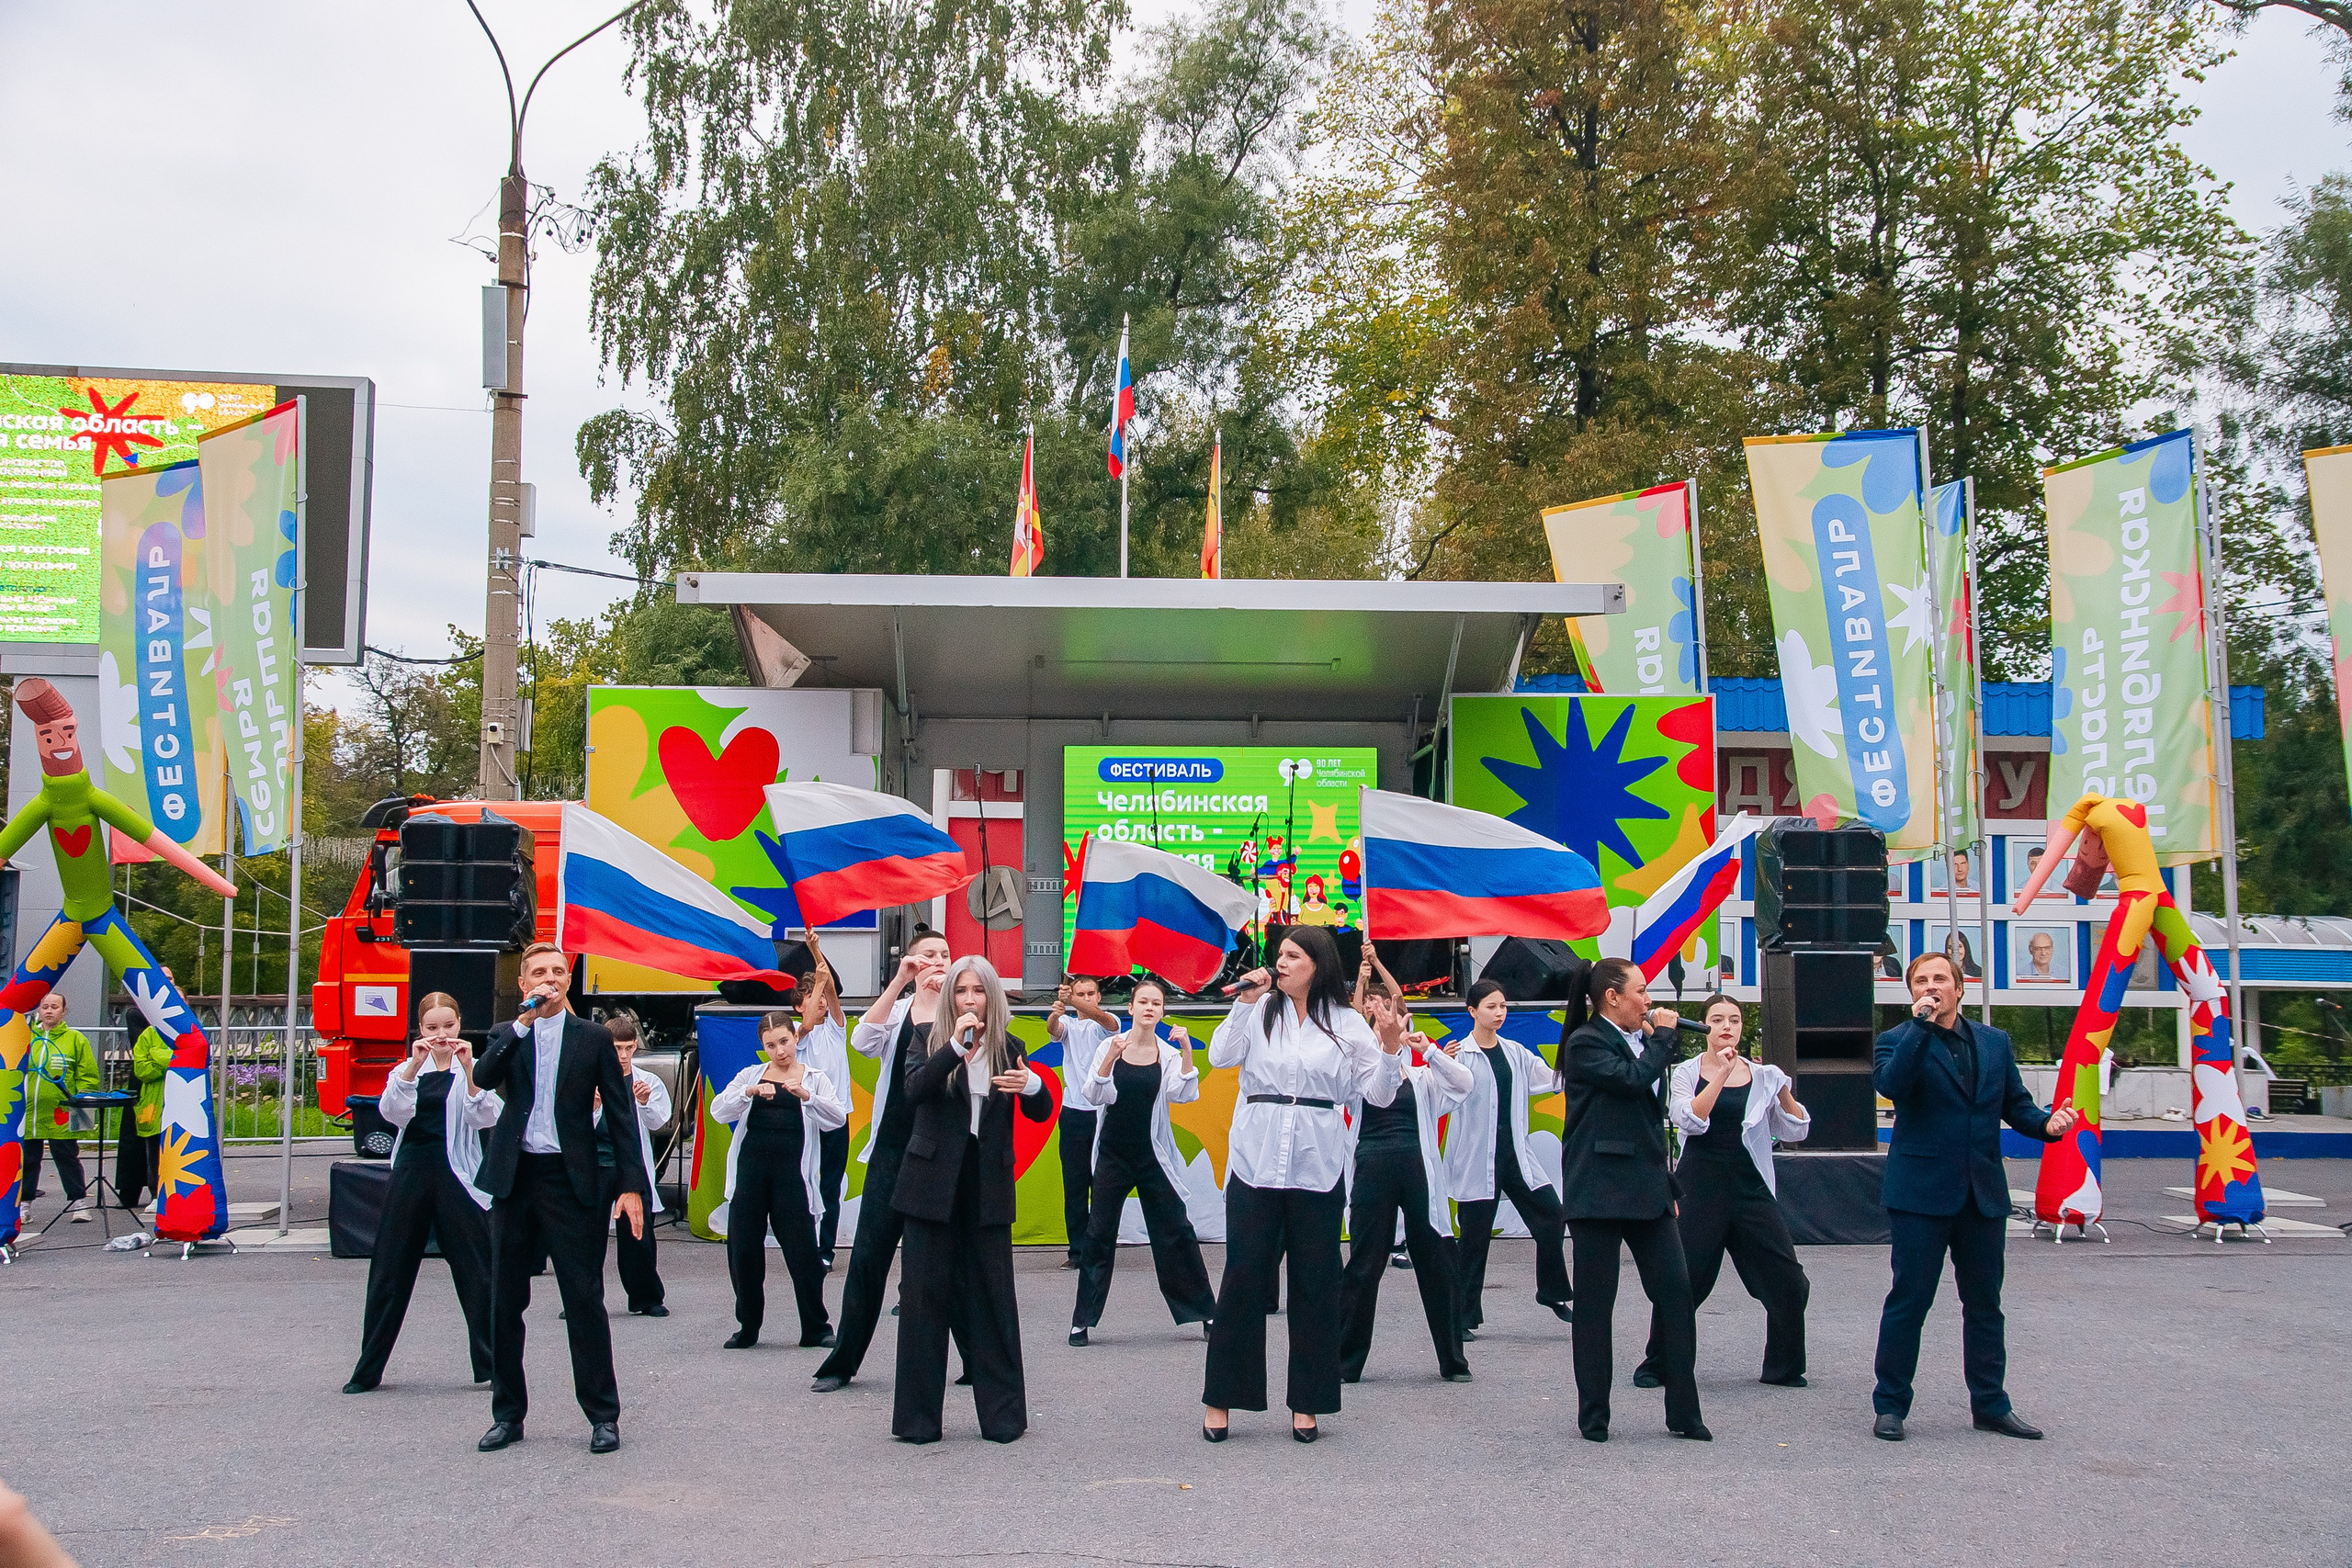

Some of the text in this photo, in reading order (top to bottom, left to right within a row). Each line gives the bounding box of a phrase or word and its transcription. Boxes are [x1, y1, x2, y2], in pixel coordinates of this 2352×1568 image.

[0, 413, 63, 432] ская
[71, 412, 179, 435] область
[16, 433, 92, 451] семья
[1110, 762, 1212, 778] ФЕСТИВАЛЬ
[1316, 759, 1341, 768] 90 ЛЕТ
[1316, 769, 1366, 778] Челябинской
[1316, 779, 1348, 787] области
[1097, 790, 1268, 813] Челябинская
[1097, 818, 1204, 841] область
